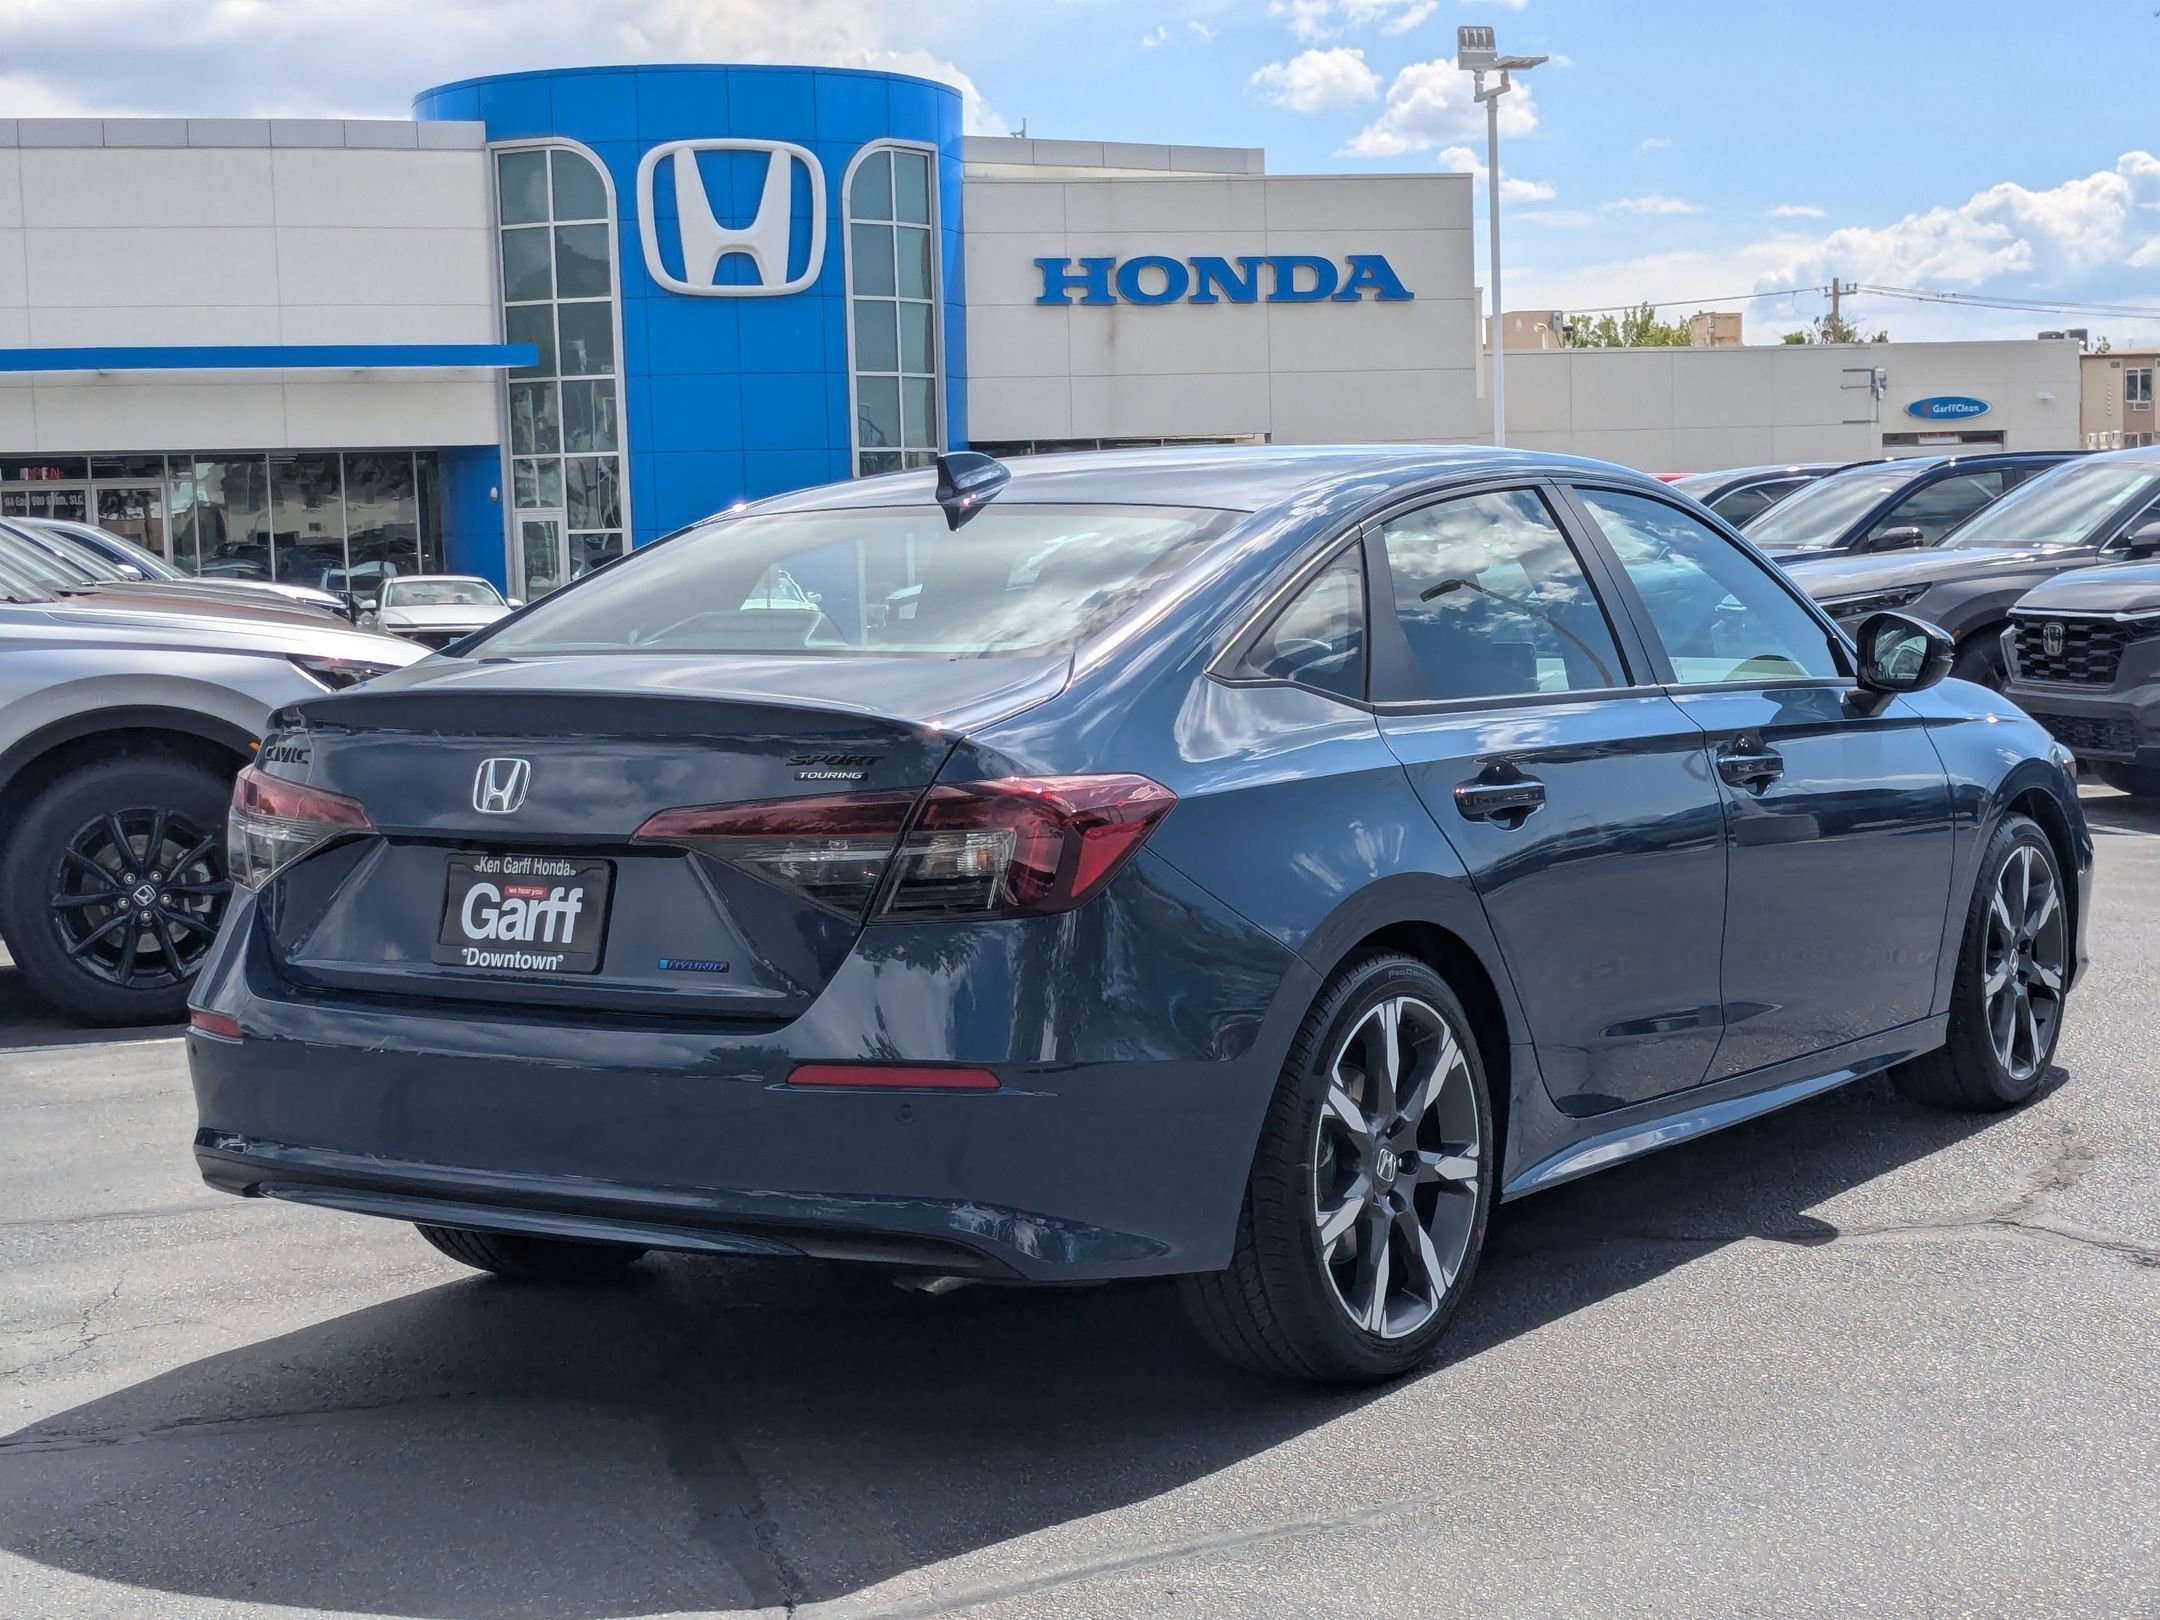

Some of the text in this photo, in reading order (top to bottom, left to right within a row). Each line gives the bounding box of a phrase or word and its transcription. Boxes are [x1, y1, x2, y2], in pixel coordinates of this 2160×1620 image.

[1033, 254, 1415, 306] HONDA
[264, 746, 312, 765] CIVIC
[785, 754, 886, 767] SPORT
[799, 771, 864, 779] TOURING
[479, 856, 571, 876] Ken Garff Honda
[461, 882, 584, 944] Garff
[466, 947, 559, 971] Downtown
[668, 960, 724, 971] HYBRID
